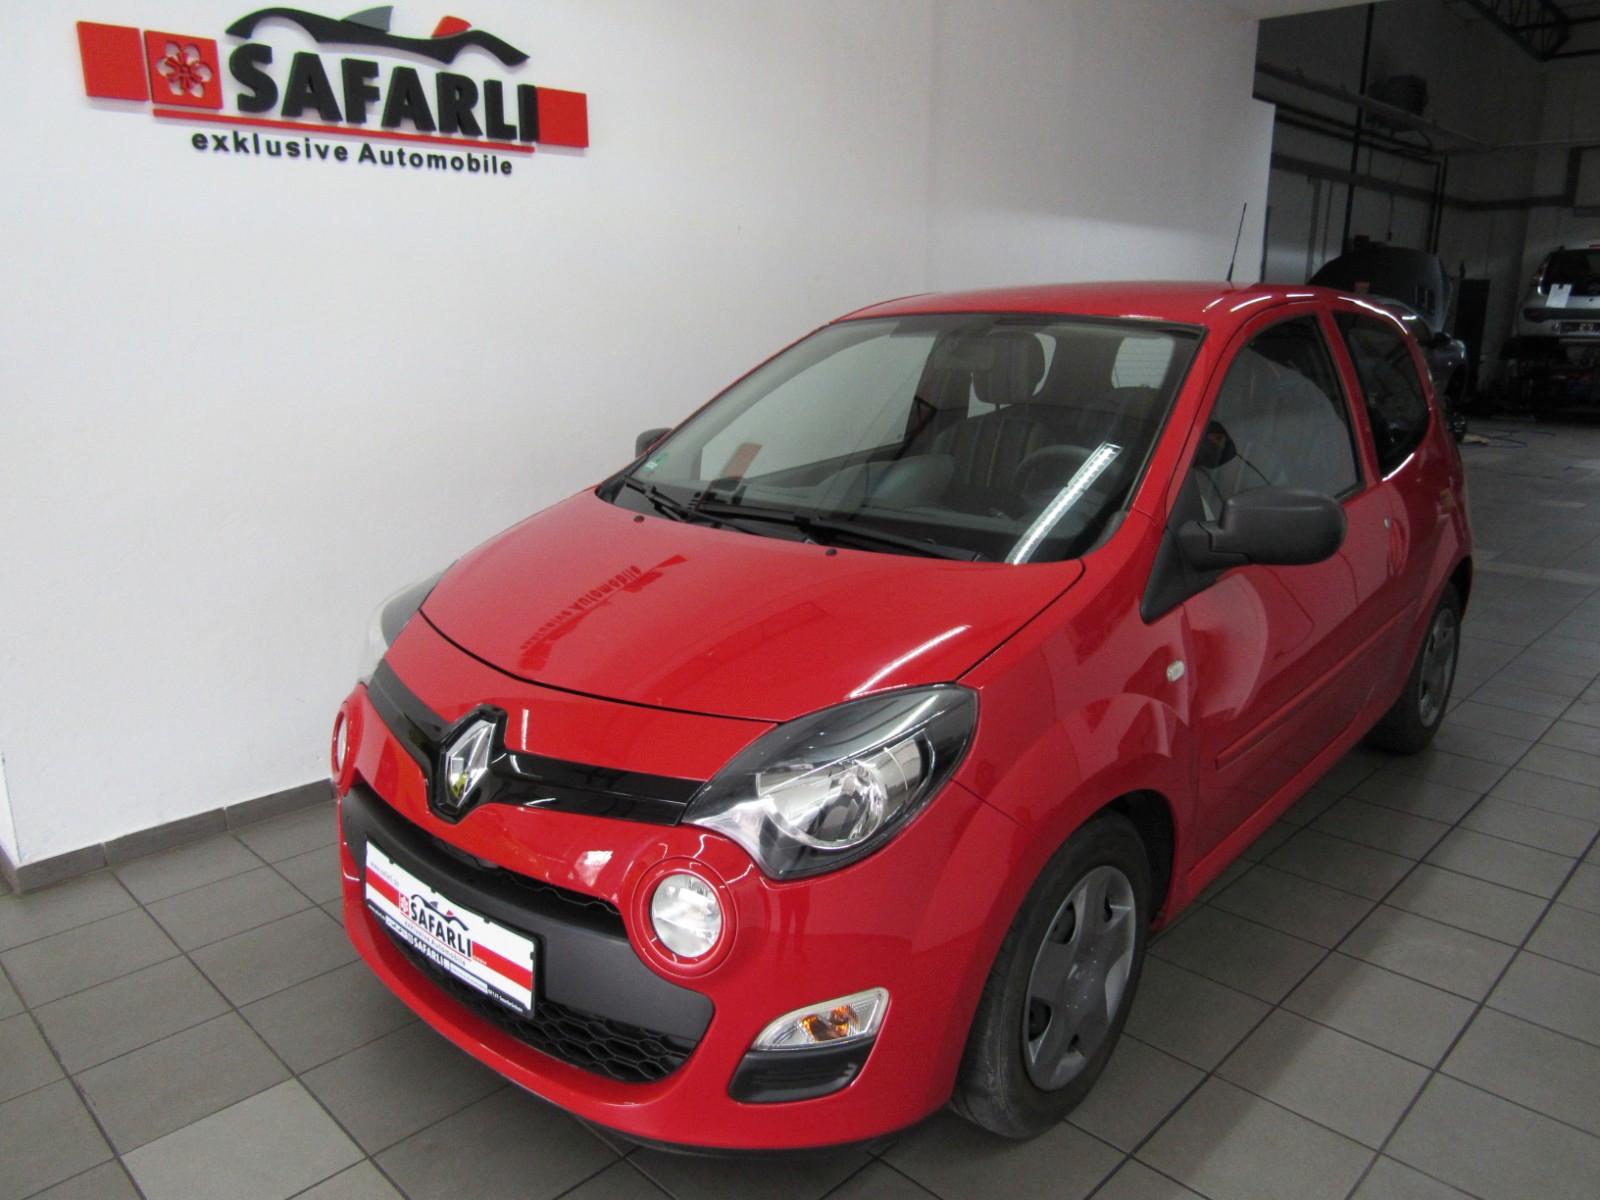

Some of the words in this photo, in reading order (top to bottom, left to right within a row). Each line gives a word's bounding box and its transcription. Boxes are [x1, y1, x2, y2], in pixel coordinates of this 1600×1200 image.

[229, 43, 539, 143] SAFARLI
[191, 130, 348, 162] exklusive
[358, 142, 514, 176] Automobile
[410, 901, 472, 957] SAFARLI
